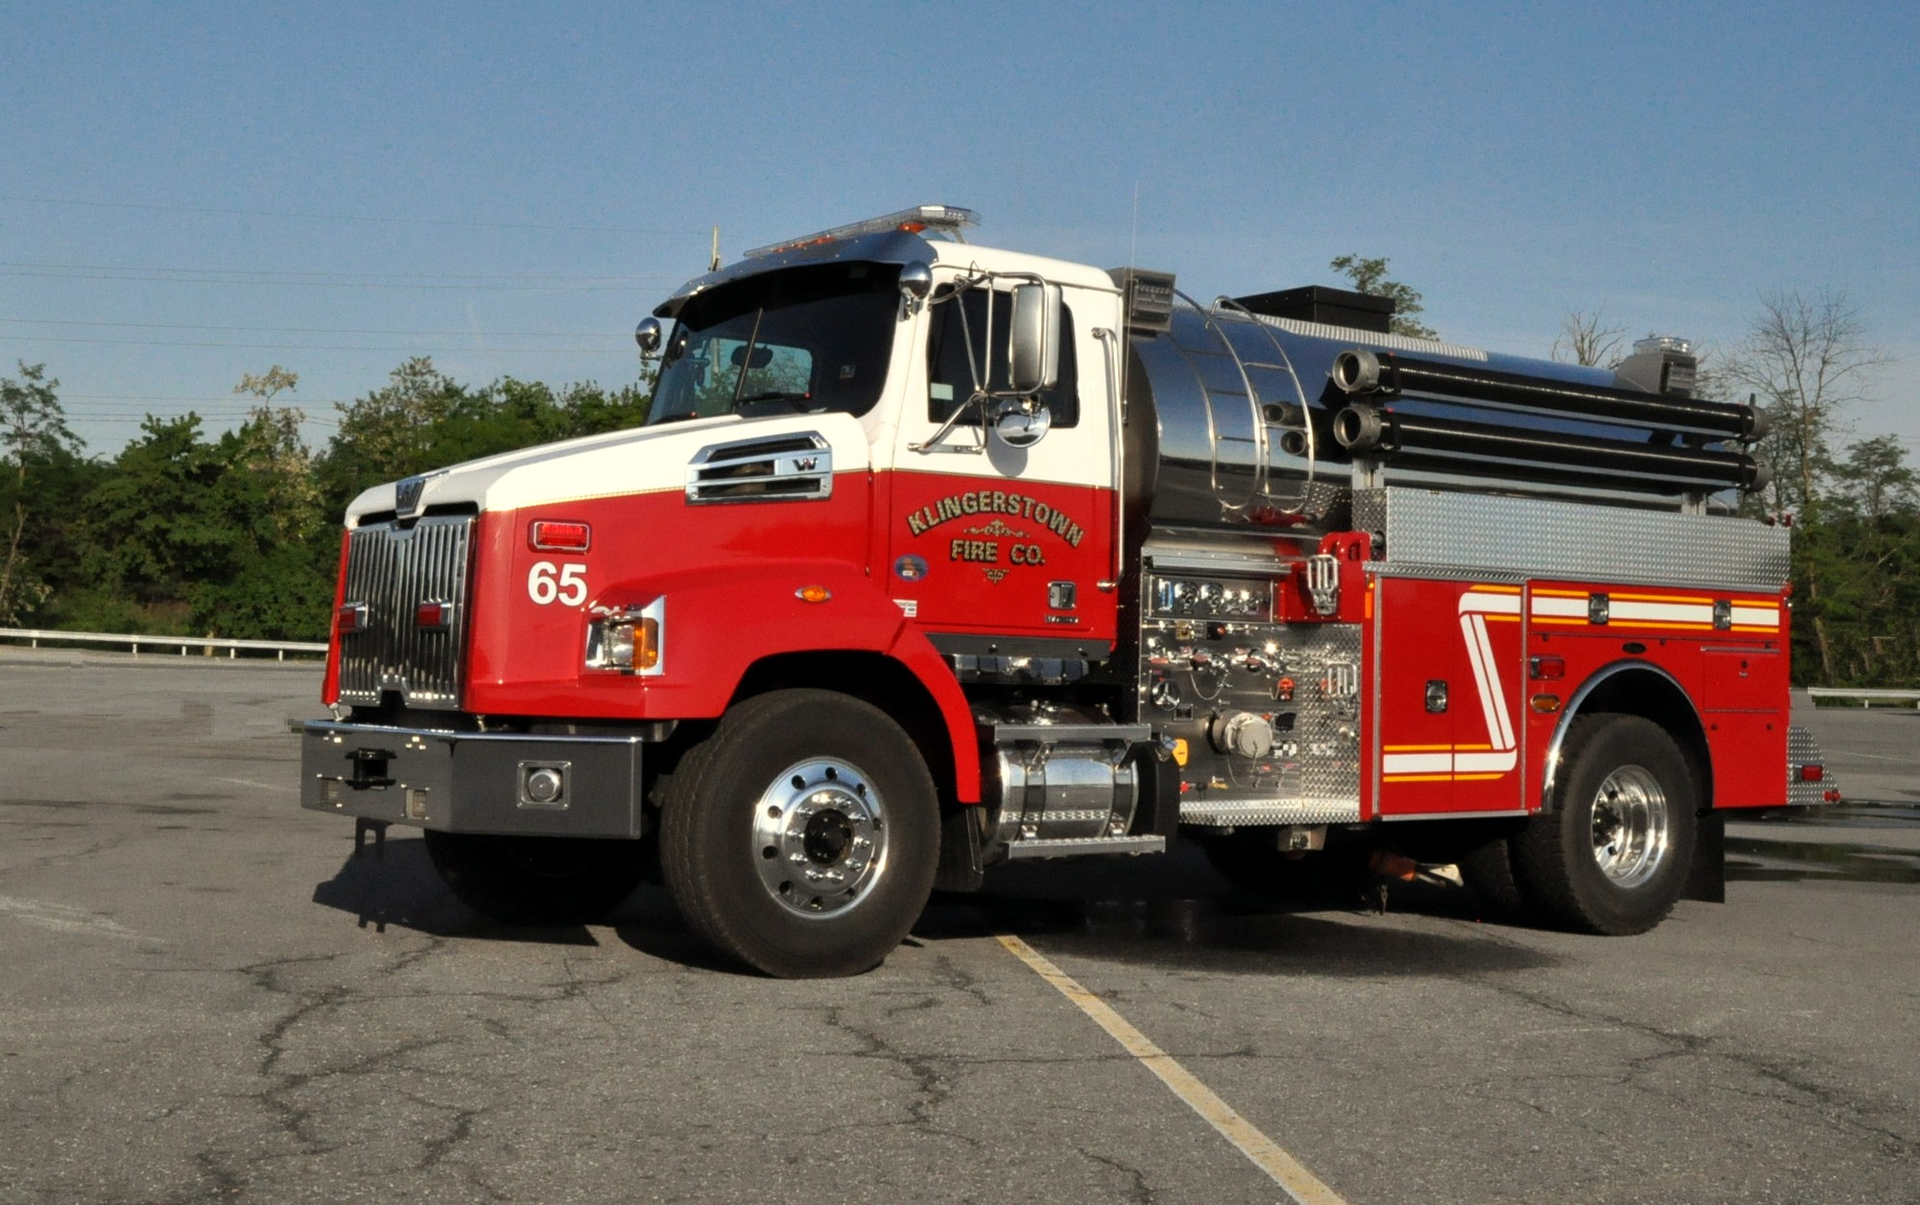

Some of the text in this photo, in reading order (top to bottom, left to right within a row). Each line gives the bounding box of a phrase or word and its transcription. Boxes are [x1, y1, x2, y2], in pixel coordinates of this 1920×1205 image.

[906, 490, 1085, 548] KLINGERSTOWN
[950, 539, 1046, 566] FIRE CO.
[527, 561, 588, 607] 65
